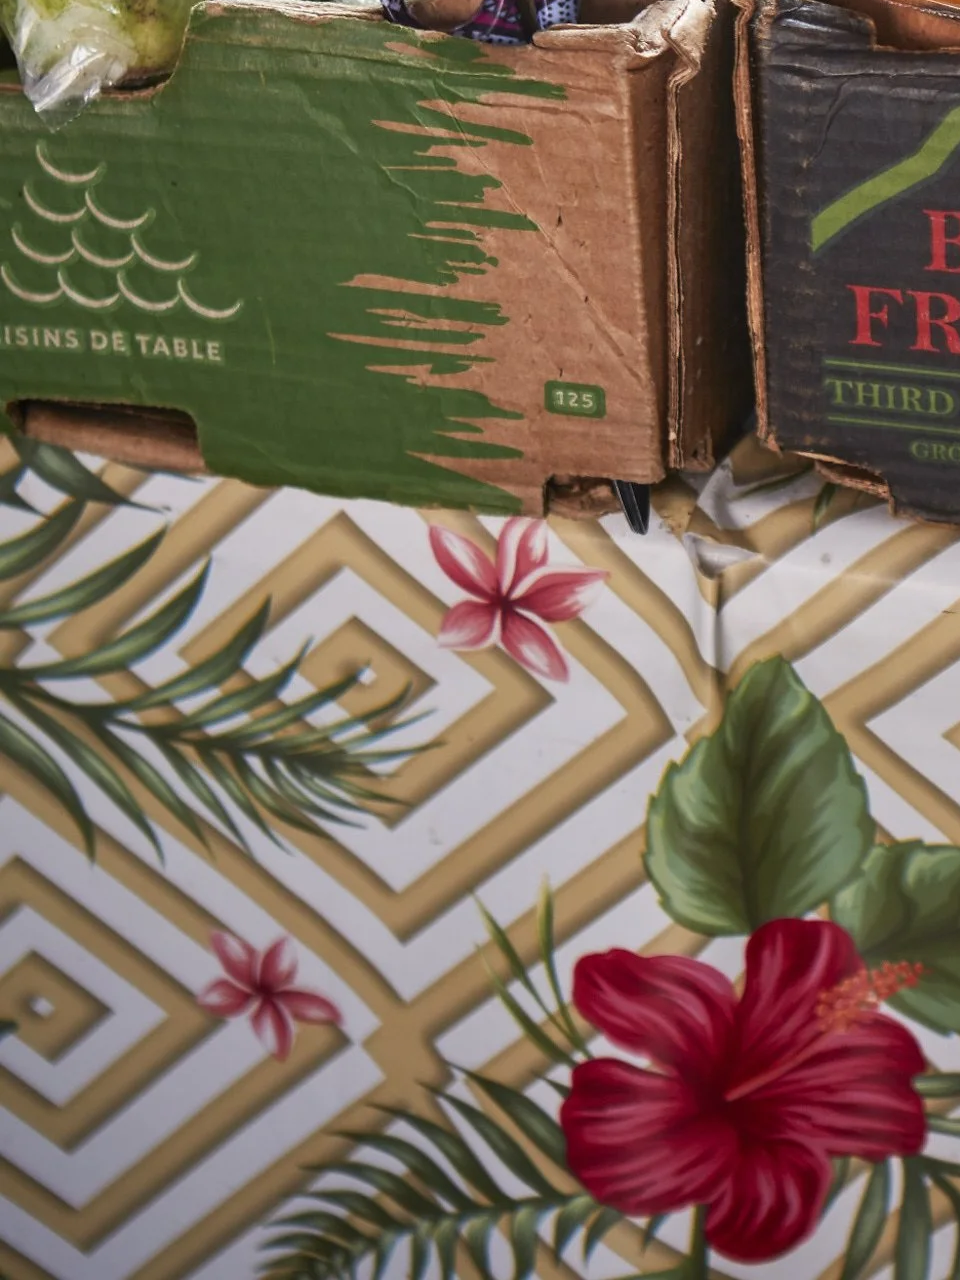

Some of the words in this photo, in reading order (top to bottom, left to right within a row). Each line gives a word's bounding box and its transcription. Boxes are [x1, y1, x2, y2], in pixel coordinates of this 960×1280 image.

[0, 325, 79, 350] ISINS
[90, 329, 126, 352] DE
[136, 334, 221, 362] TABLE
[555, 391, 593, 408] 125
[825, 378, 954, 417] THIRD
